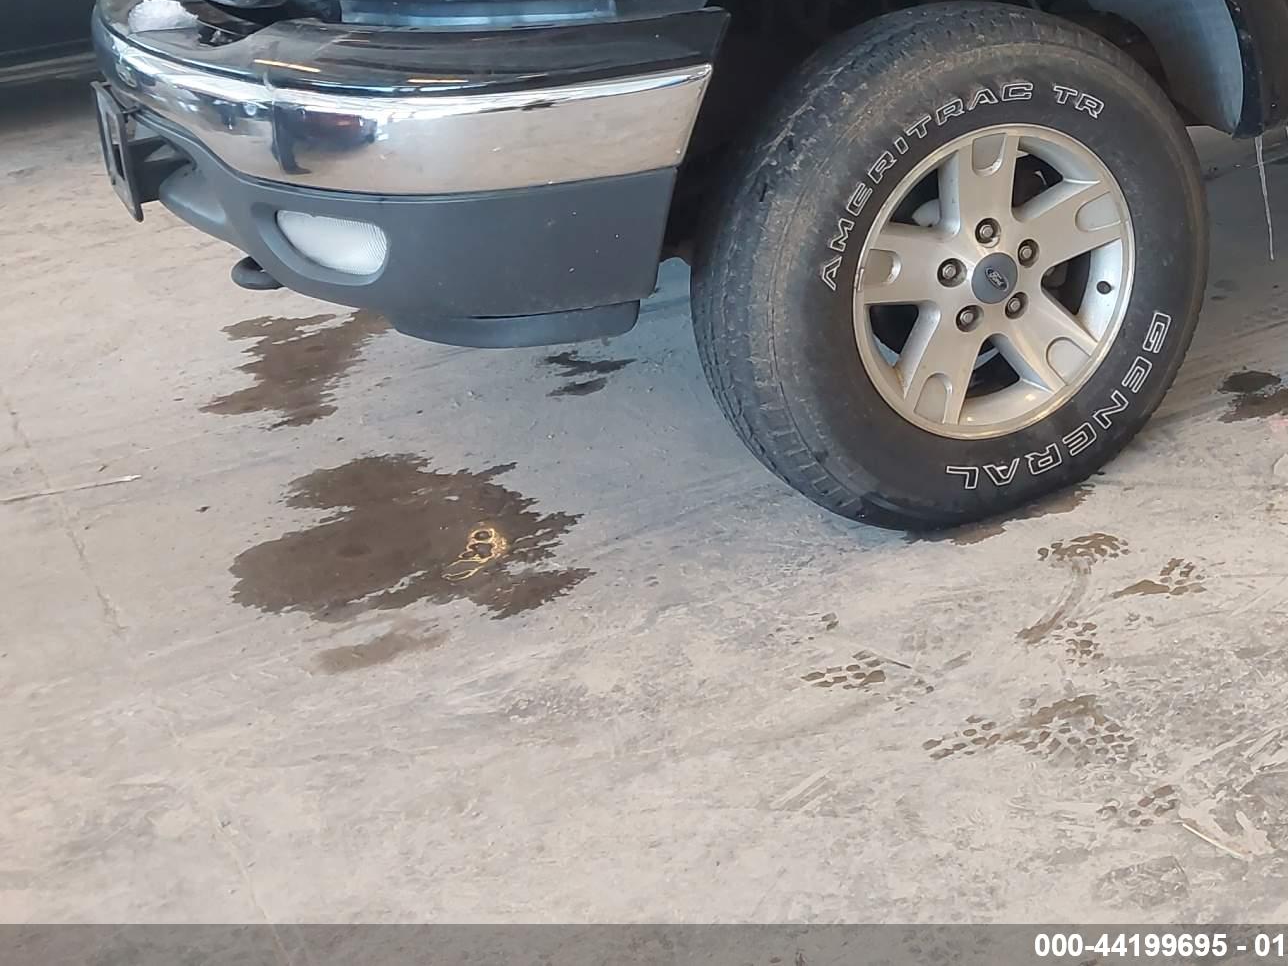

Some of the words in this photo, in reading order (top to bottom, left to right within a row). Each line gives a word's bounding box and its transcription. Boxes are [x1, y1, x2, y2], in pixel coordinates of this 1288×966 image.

[820, 82, 1034, 291] AMERITRAC
[1053, 85, 1105, 119] TR
[946, 312, 1172, 490] GENERAL
